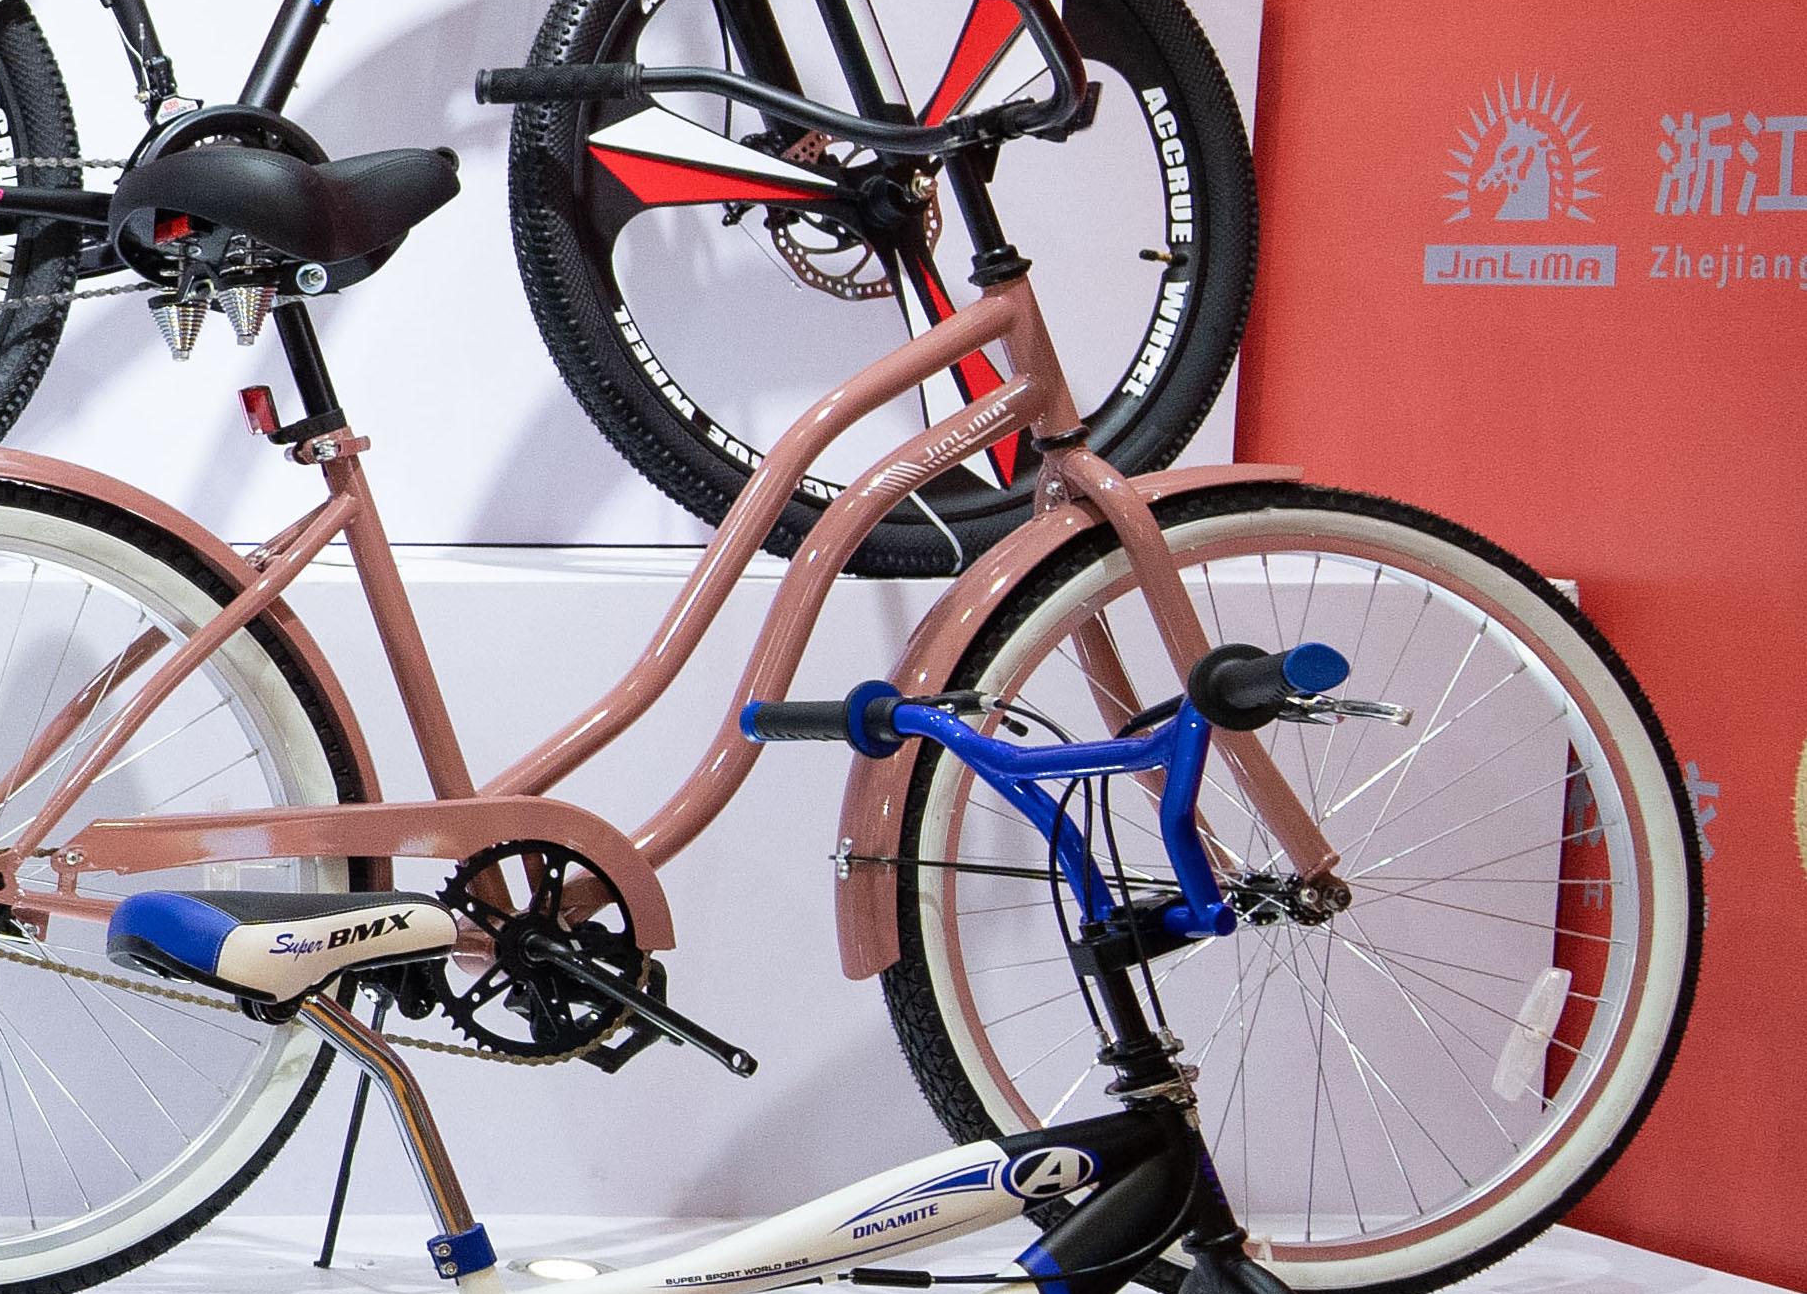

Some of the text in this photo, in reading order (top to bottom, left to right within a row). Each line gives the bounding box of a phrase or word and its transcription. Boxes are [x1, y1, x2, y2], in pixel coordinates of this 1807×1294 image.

[1121, 87, 1194, 398] ACCRUE WHEEL
[613, 304, 697, 421] WHEEL
[268, 909, 415, 963] Super BMX
[1019, 1153, 1081, 1195] A
[851, 1202, 941, 1241] DINAMITE
[665, 1257, 810, 1286] SUPER SPORT WORLD BIKE
